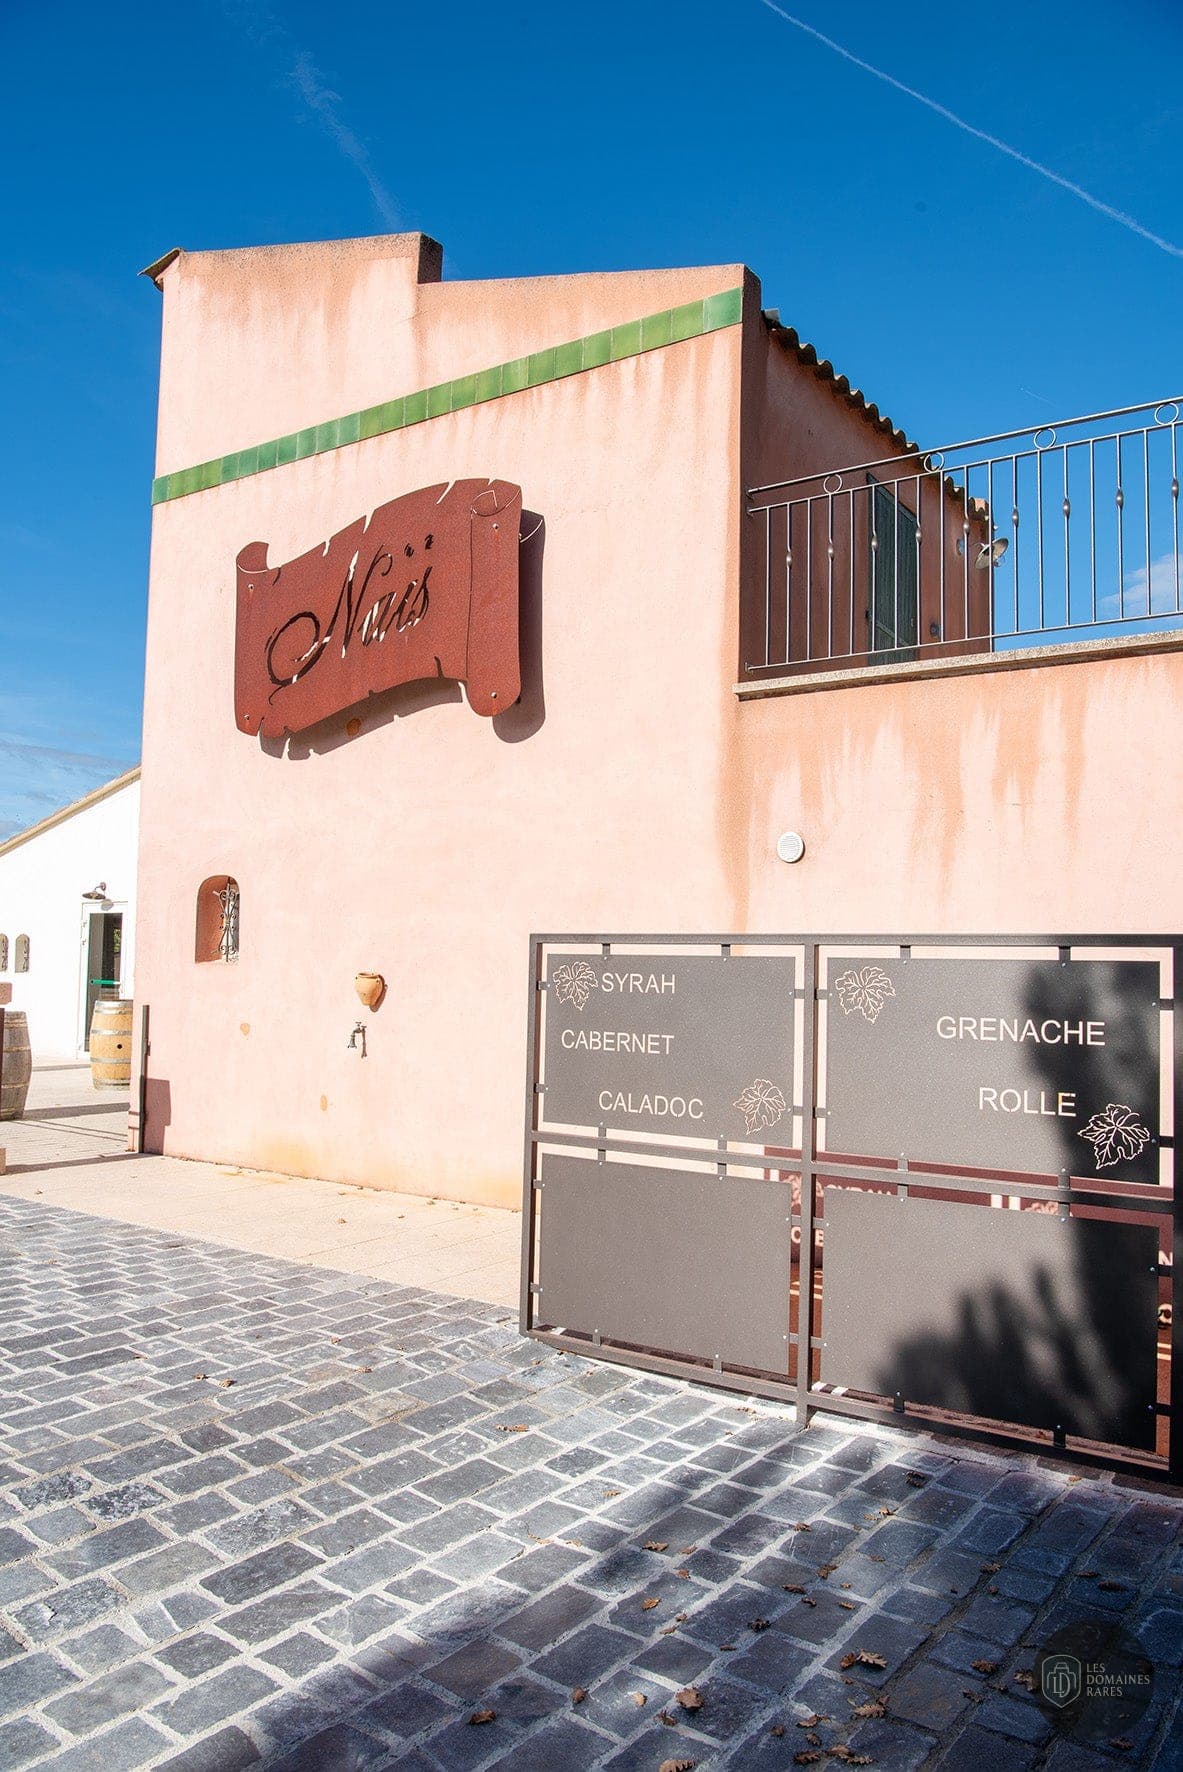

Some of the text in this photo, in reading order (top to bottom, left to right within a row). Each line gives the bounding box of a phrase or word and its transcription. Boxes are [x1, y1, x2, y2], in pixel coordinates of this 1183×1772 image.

[600, 972, 676, 994] SYRAH
[561, 1029, 675, 1055] CABERNET
[936, 1015, 1106, 1046] GRENACHE
[598, 1090, 704, 1119] CALADOC
[978, 1086, 1077, 1118] ROLLE
